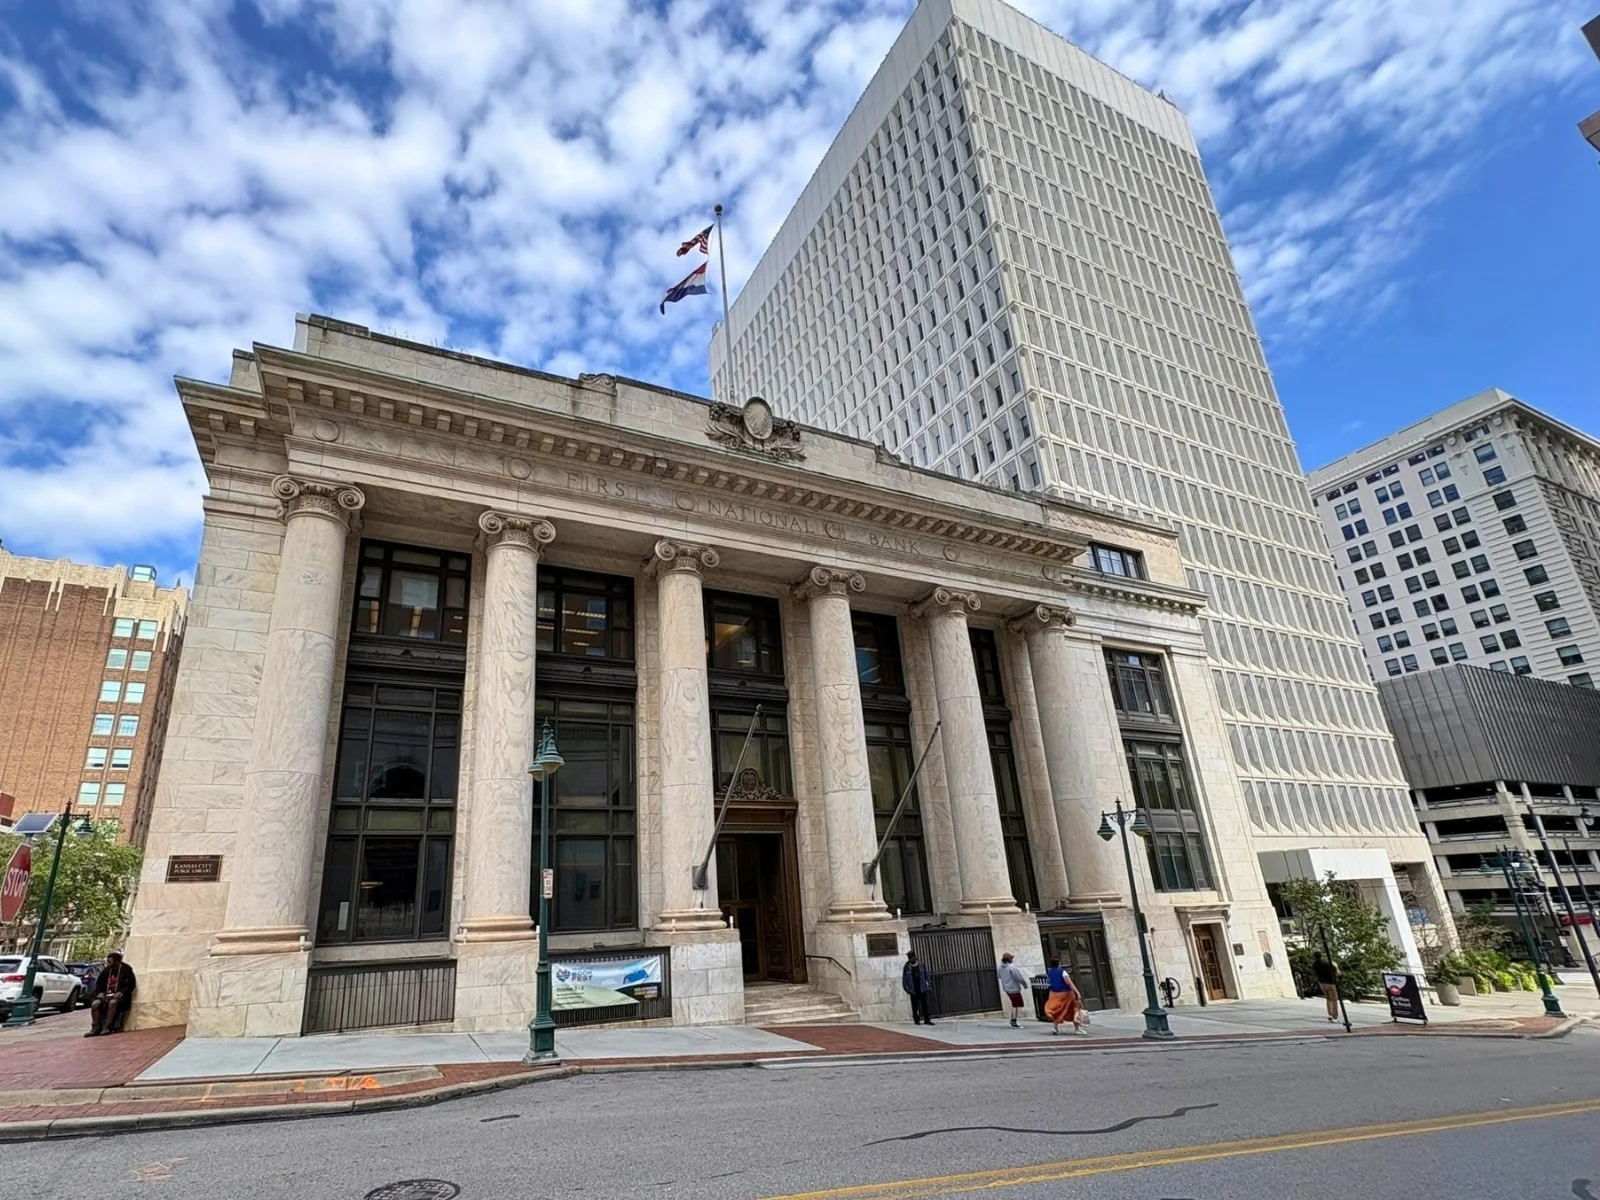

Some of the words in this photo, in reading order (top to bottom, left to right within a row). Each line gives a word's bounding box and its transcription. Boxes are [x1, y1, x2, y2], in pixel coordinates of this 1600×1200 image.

[566, 473, 643, 500] FIRST
[708, 500, 815, 534] NATIONAL
[869, 532, 921, 555] BANK
[4, 867, 28, 897] STOP
